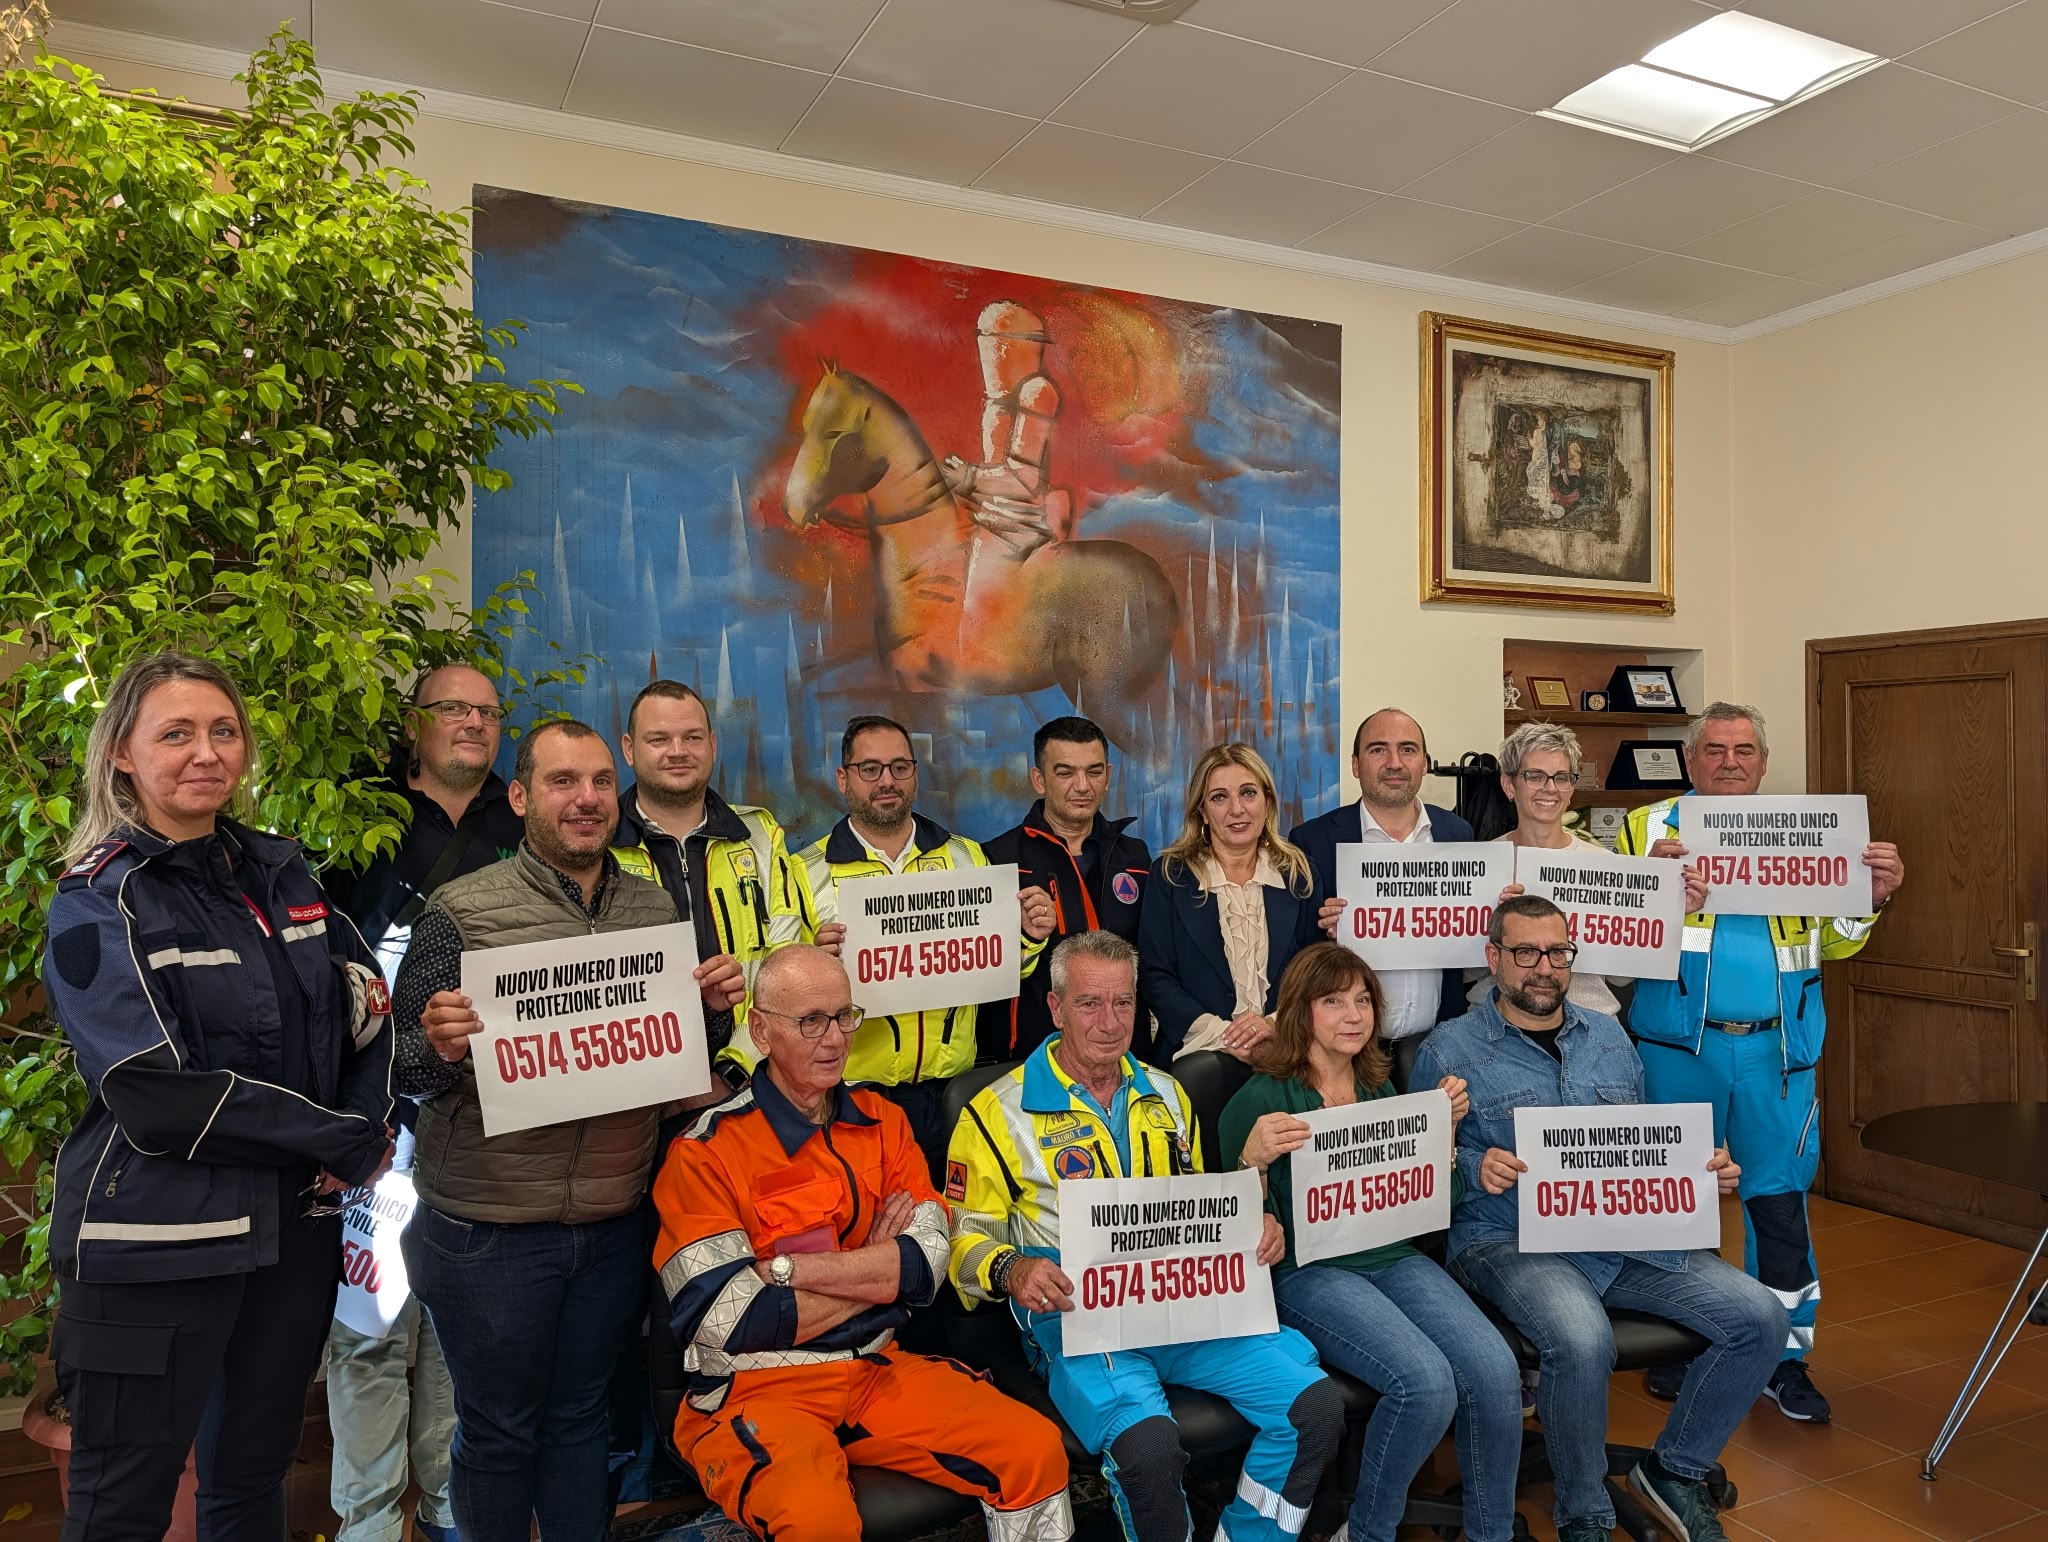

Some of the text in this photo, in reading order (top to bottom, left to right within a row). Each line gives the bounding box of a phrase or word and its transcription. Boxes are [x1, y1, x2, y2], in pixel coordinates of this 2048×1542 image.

[1704, 813, 1837, 828] NUOVO NUMERO UNICO
[1720, 832, 1823, 846] PROTEZIONE CIVILE
[1362, 861, 1485, 878] NUOVO NUMERO UNICO
[1540, 867, 1659, 891] NUOVO NUMERO UNICO
[1696, 856, 1847, 886] 0574 558500
[865, 886, 992, 916] NUOVO NUMERO UNICO
[1377, 881, 1471, 897] PROTEZIONE CIVILE
[1553, 887, 1644, 908] PROTEZIONE CIVILE
[882, 909, 979, 935] PROTEZIONE CIVILE
[1354, 906, 1492, 938] 0574 558500
[1584, 914, 1663, 949] 558500
[858, 934, 1002, 984] 0574 558500
[495, 951, 663, 998] NUOVO NUMERO UNICO
[516, 981, 646, 1022] PROTEZIONE CIVILE
[495, 1011, 682, 1083] 0574 558500
[1051, 1131, 1075, 1145] MAURO
[1315, 1114, 1427, 1152] NUOVO NUMERO UNICO
[1543, 1126, 1681, 1147] NUOVO NUMERO UNICO
[1329, 1139, 1416, 1172] PROTEZIONE CIVILE
[1561, 1149, 1667, 1169] PROTEZIONE CIVILE
[1307, 1164, 1434, 1223] 0574 558500
[1537, 1177, 1695, 1216] 0574 558500
[1091, 1196, 1237, 1227] NUOVO NUMERO UNICO
[1112, 1223, 1221, 1252] PROTEZIONE CIVILE
[343, 1240, 383, 1294] 500
[1083, 1253, 1245, 1310] 0574 558500
